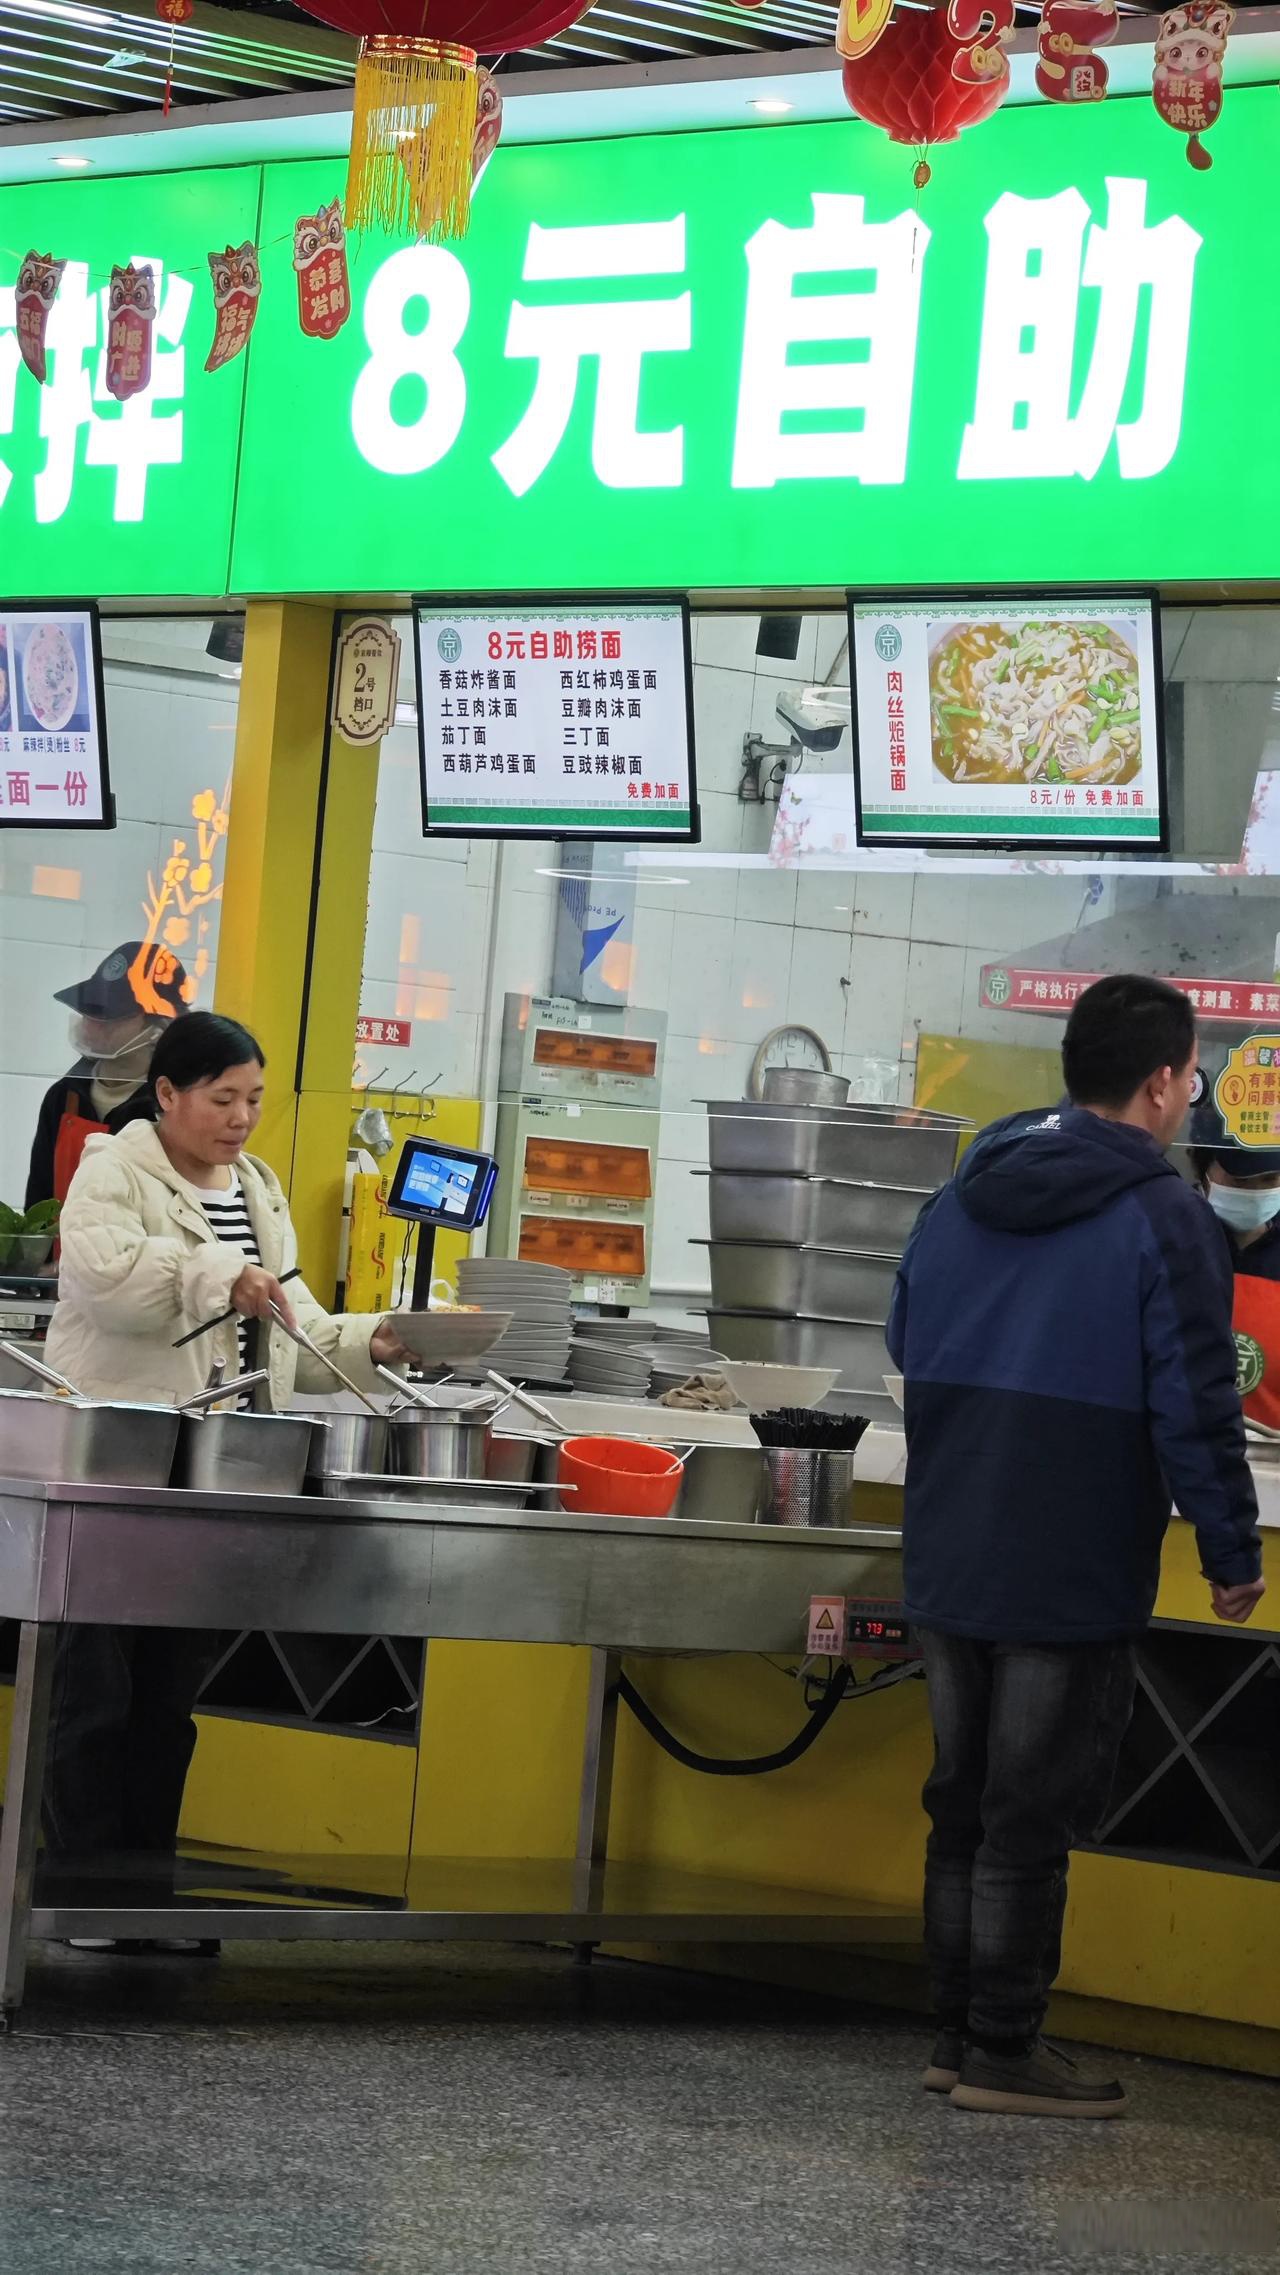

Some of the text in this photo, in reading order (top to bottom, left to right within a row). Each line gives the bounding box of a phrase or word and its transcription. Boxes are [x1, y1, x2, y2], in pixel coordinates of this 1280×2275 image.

[1168, 75, 1205, 102] 新年
[1168, 102, 1208, 128] 快乐
[309, 258, 342, 291] 恭喜
[310, 286, 345, 320] 发财
[351, 176, 1204, 498] 8元自助
[488, 630, 622, 660] 8元自助捞面
[354, 662, 376, 692] 2号
[439, 670, 657, 690] 香菇炸酱面 西红柿鸡蛋面
[441, 698, 641, 718] 土豆肉沫面 豆瓣肉沫面
[442, 727, 609, 746] 茄丁面 三丁面
[887, 671, 906, 791] 肉丝炝锅面
[443, 754, 642, 775] 西葫芦鸡蛋面 豆豉辣椒面
[0, 771, 88, 807] 面一份
[627, 782, 679, 799] 免费加面
[1030, 789, 1144, 806] 8元/份 免费加面
[1178, 987, 1280, 1012] 度测量：素菜
[356, 1021, 400, 1042] 放置处
[1249, 1073, 1280, 1088] 有事
[1248, 1091, 1280, 1106] 问题
